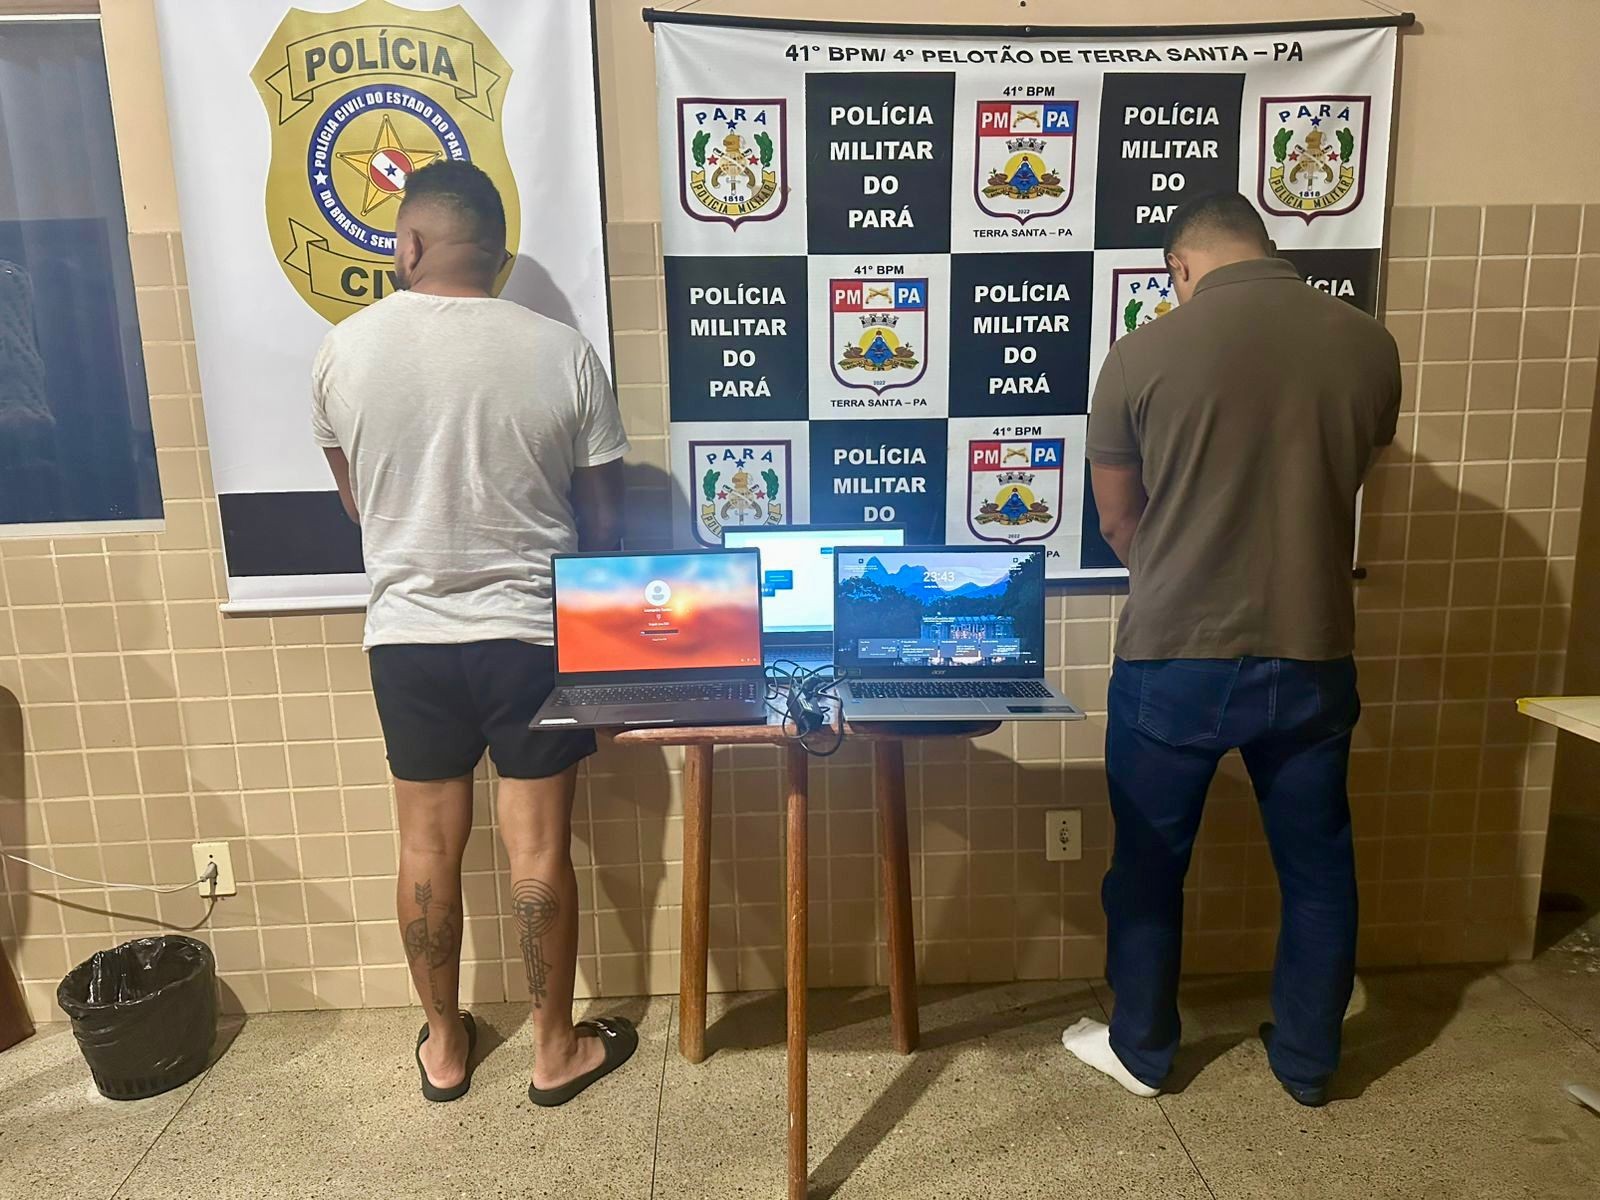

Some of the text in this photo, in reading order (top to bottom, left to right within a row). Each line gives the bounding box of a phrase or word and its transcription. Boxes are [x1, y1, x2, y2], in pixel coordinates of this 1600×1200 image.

[305, 29, 458, 82] POLÍCIA
[828, 46, 887, 62] BPM/
[922, 45, 1034, 64] PELOTÃO
[1039, 50, 1073, 64] DE
[1077, 48, 1162, 64] TERRA
[1166, 45, 1248, 62] SANTA
[1273, 41, 1303, 62] PA
[1026, 86, 1055, 96] BPM
[695, 107, 767, 125] PARÁ
[830, 101, 934, 126] POLÍCIA
[981, 111, 1070, 129] PM PA
[1124, 102, 1219, 125] POLÍCIA
[1279, 104, 1350, 123] PARÁ
[315, 91, 465, 168] POLÍCIA CIVIL DO ESTADO DO PAR
[830, 141, 934, 160] MILITAR
[1121, 140, 1219, 159] MILITAR
[863, 175, 899, 195] DO
[1151, 173, 1185, 192] DO
[738, 184, 773, 213] MILITAR
[1313, 180, 1350, 208] MILITAR
[320, 190, 335, 208] DO
[330, 206, 368, 243] BRASIL,
[848, 204, 914, 228] PARÁ
[973, 229, 1009, 238] TERRA
[1011, 228, 1047, 237] SANTA
[1058, 228, 1073, 237] PA
[876, 265, 904, 275] BPM
[690, 283, 786, 305] POLÍCIA
[835, 287, 921, 305] PM PA
[974, 280, 1070, 303] POLÍCIA
[690, 319, 787, 336] MILITAR
[973, 315, 1070, 334] MILITAR
[723, 349, 756, 367] DO
[1004, 346, 1037, 364] DO
[709, 376, 771, 397] PARÁ
[989, 372, 1050, 395] PARÁ
[831, 400, 865, 408] TERRA
[868, 399, 902, 407] SANTA
[913, 398, 928, 407] PA
[1015, 426, 1042, 436] BPM
[834, 444, 927, 465] POLÍCIA
[973, 447, 1057, 465] PM PA
[833, 477, 927, 494] MILITAR
[864, 506, 896, 522] DO
[1046, 550, 1060, 558] PA
[923, 571, 955, 582] 23:43
